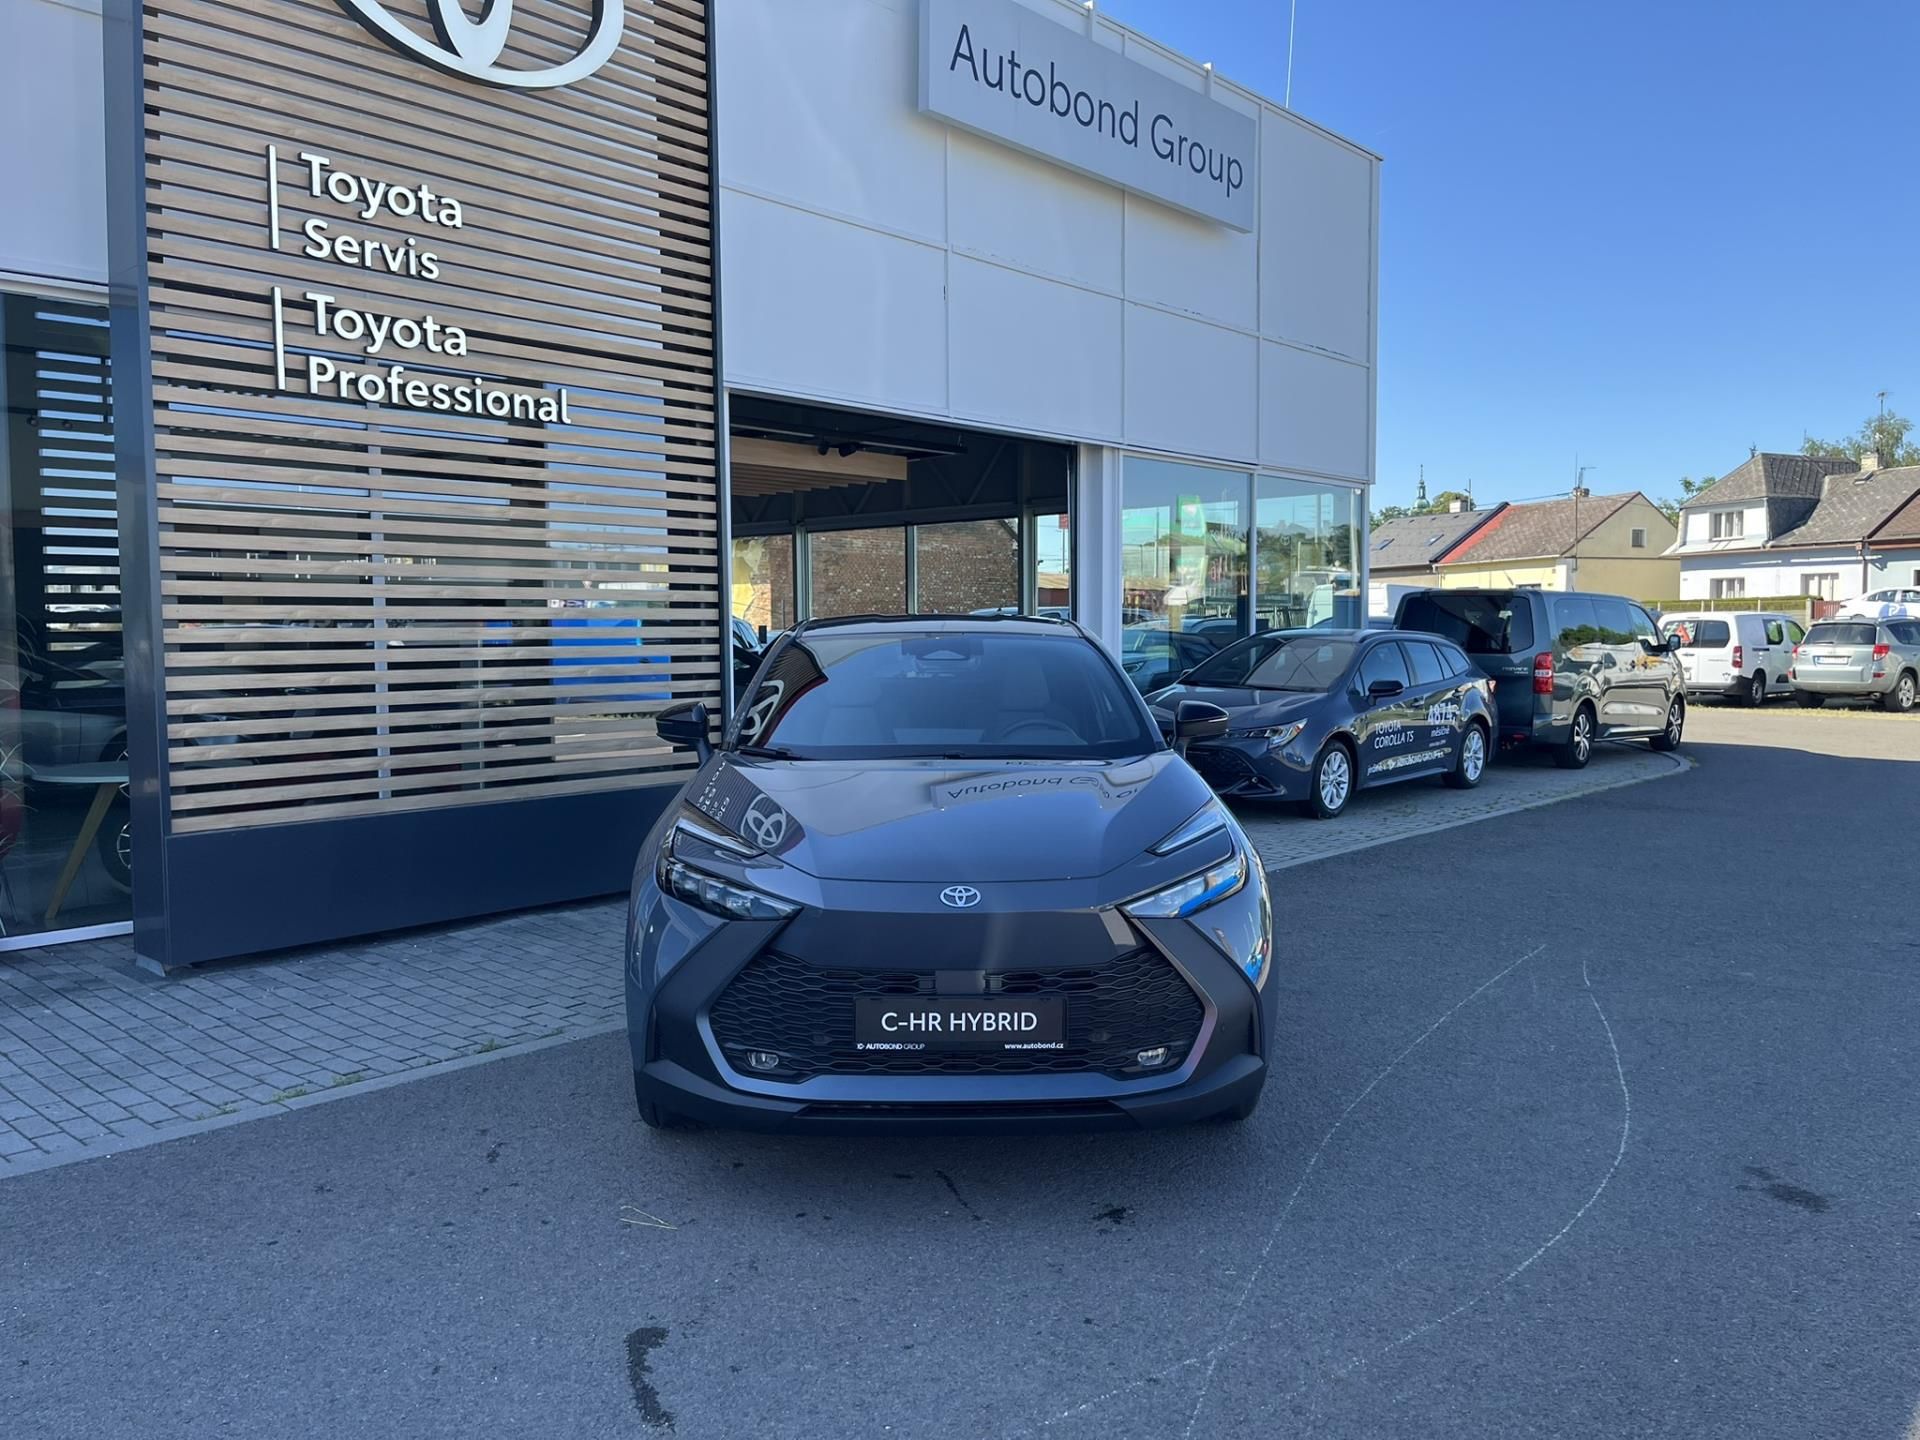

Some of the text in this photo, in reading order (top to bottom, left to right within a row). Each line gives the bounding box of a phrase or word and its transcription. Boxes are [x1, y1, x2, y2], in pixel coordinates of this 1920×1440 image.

[950, 24, 1244, 198] Autobond Group
[300, 152, 463, 228] Toyota
[304, 218, 440, 280] Servis
[305, 291, 468, 356] Toyota
[307, 355, 571, 424] Professional
[1374, 730, 1414, 749] COROLLA TS
[1375, 719, 1402, 735] TOYOTA
[881, 1012, 1037, 1031] C-HR HYBRID
